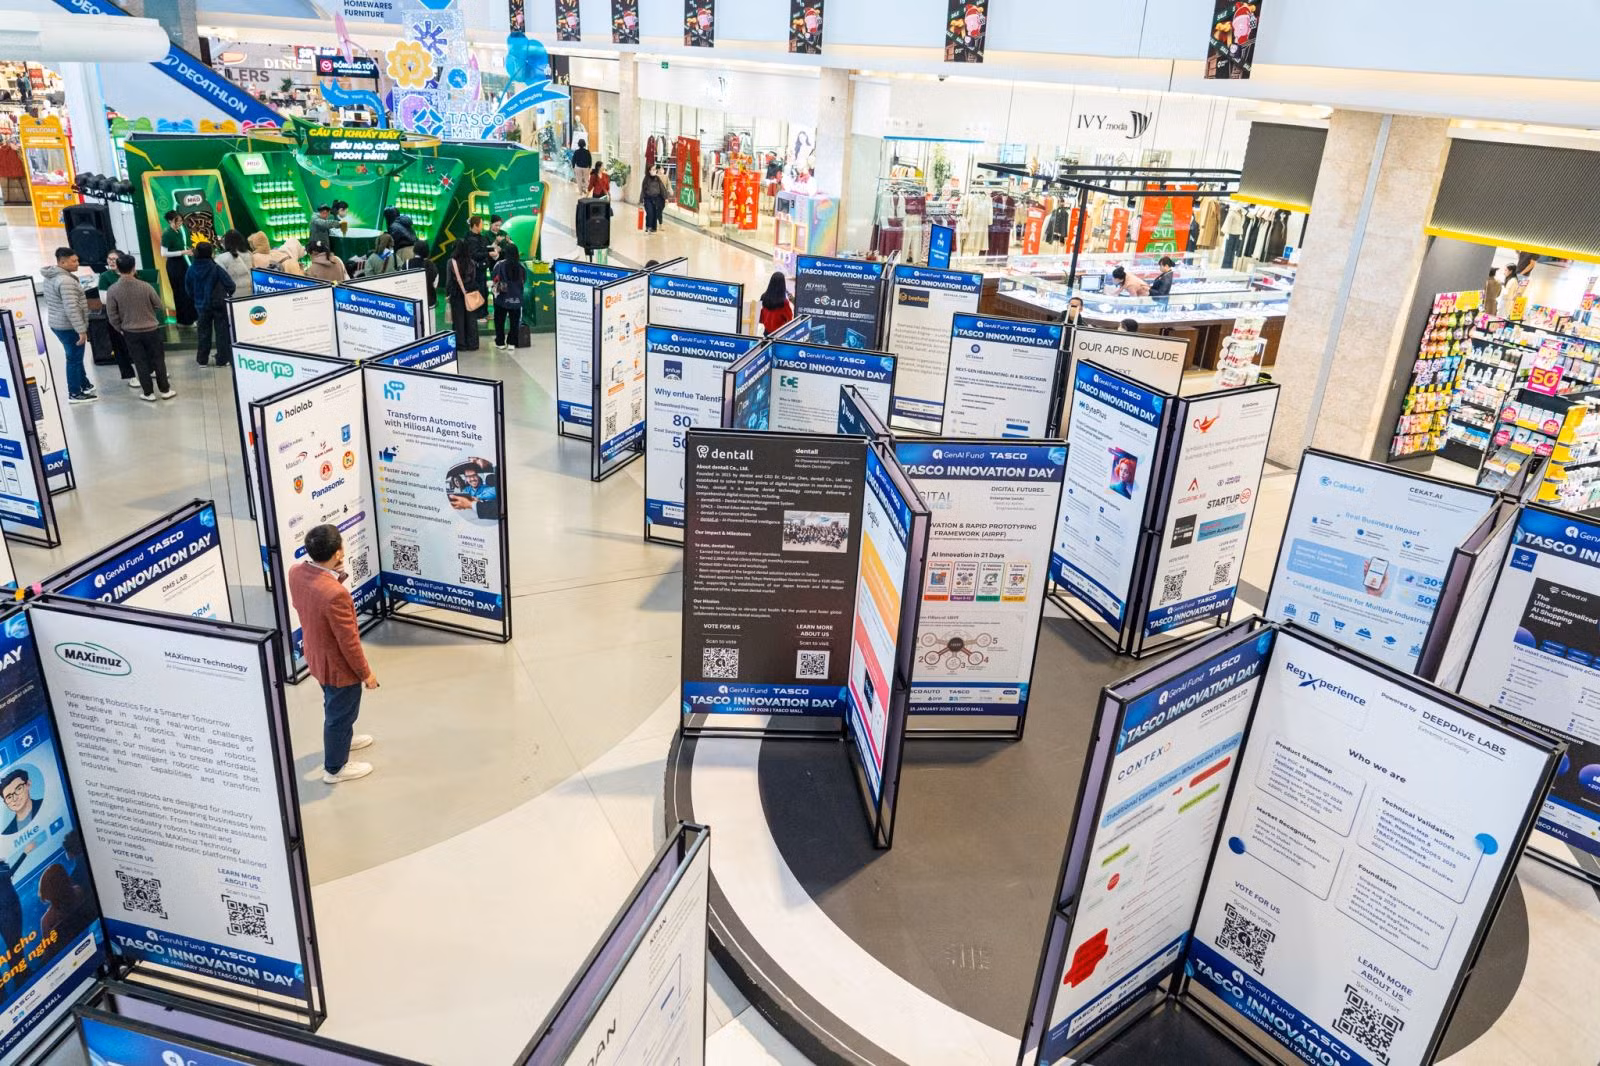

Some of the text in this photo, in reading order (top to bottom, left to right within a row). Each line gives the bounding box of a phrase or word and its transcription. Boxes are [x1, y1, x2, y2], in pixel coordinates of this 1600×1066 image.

[344, 9, 384, 18] FURNITURE
[177, 62, 248, 114] DECATHLON
[450, 114, 505, 126] TASCO
[1077, 115, 1107, 129] IVY
[452, 129, 480, 139] Mall
[921, 281, 961, 290] INNOVATION
[653, 288, 675, 296] TASCO
[676, 291, 718, 303] INNOVATION
[719, 297, 733, 305] DAY
[958, 329, 1054, 346] TASCO INNOVATION DAY
[652, 343, 735, 360] TASCO INNOVATION
[1079, 341, 1179, 363] OUR APIS INCLUDE
[778, 360, 886, 380] TASCO INNOVATION DAY
[1079, 382, 1156, 422] TASCO INNOVATION DAY
[1086, 403, 1107, 420] BytePlus
[384, 419, 402, 428] with
[435, 427, 459, 438] Agent
[461, 430, 483, 441] Suite
[387, 409, 477, 430] Transform Automotive
[711, 449, 754, 460] dentall
[902, 464, 1055, 478] TASCO INNOVATION DAY
[311, 477, 345, 500] Panasonic
[1409, 486, 1443, 500] CEKAT.AI
[1207, 494, 1241, 509] STARTUP
[1345, 511, 1421, 537] Real Business Impact
[113, 533, 212, 600] INNOVATION DAY
[162, 574, 188, 593] DMS LAB
[388, 583, 496, 612] TASCO INNOVATION DAY
[1537, 593, 1550, 601] The
[1561, 590, 1588, 603] Cleed.ai
[1150, 598, 1230, 629] TASCO INNOVATION DAY
[1540, 609, 1573, 625] Shopping
[164, 652, 248, 673] MAXimuz Technology
[1513, 644, 1583, 672] The most comprehensive
[691, 695, 837, 708] TASCO INNOVATION DAY
[1128, 661, 1260, 743] TASCO INNOVATION DAY
[1380, 692, 1418, 713] Powered by
[1421, 711, 1507, 757] DEEPDIVE LABS
[1523, 719, 1542, 730] return
[1550, 729, 1584, 746] investment
[1349, 748, 1407, 784] Who we are
[1381, 797, 1456, 840] Technical Validation
[13, 824, 40, 849] Mike
[112, 848, 129, 858] VOTE
[130, 852, 144, 860] FOR
[218, 868, 261, 882] LEARN MORE
[224, 878, 259, 890] ABOUT US
[1358, 863, 1398, 890] Foundation
[1234, 880, 1281, 914] VOTE FOR US
[116, 935, 294, 988] TASCO INNOVATION DAY
[1357, 955, 1414, 997] LEARN MORE
[1360, 969, 1405, 1002] ABOUT US
